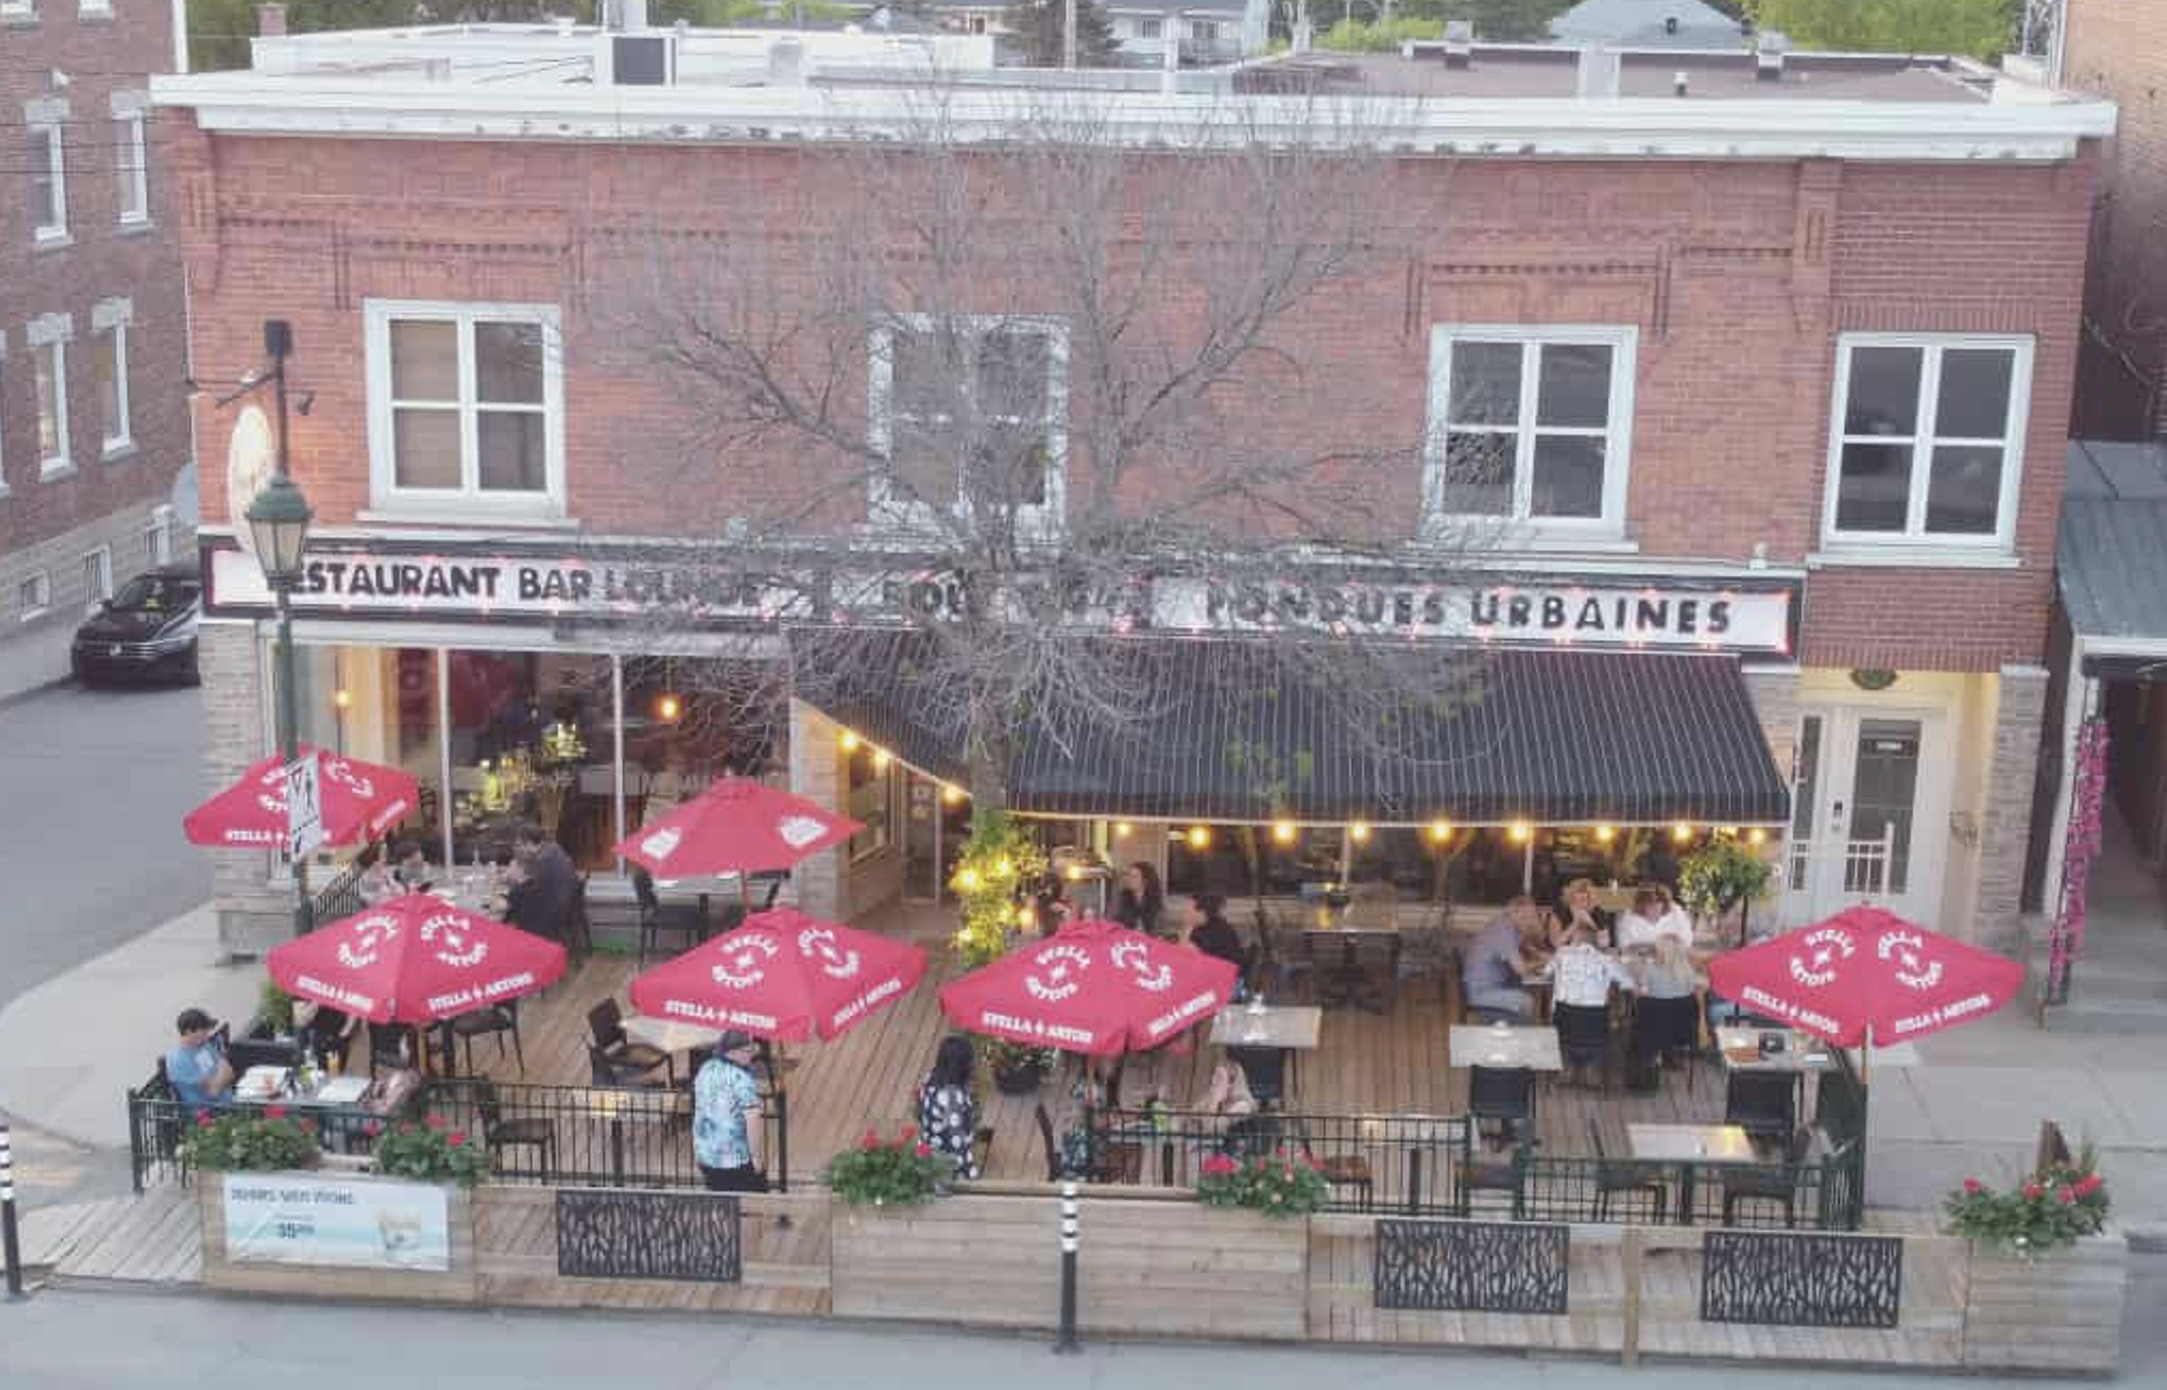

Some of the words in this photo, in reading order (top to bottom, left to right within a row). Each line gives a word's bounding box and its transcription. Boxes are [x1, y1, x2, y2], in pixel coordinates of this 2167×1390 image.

[285, 562, 502, 597] STAURANT
[518, 566, 592, 601] BAR
[1470, 591, 1731, 633] URBAINES
